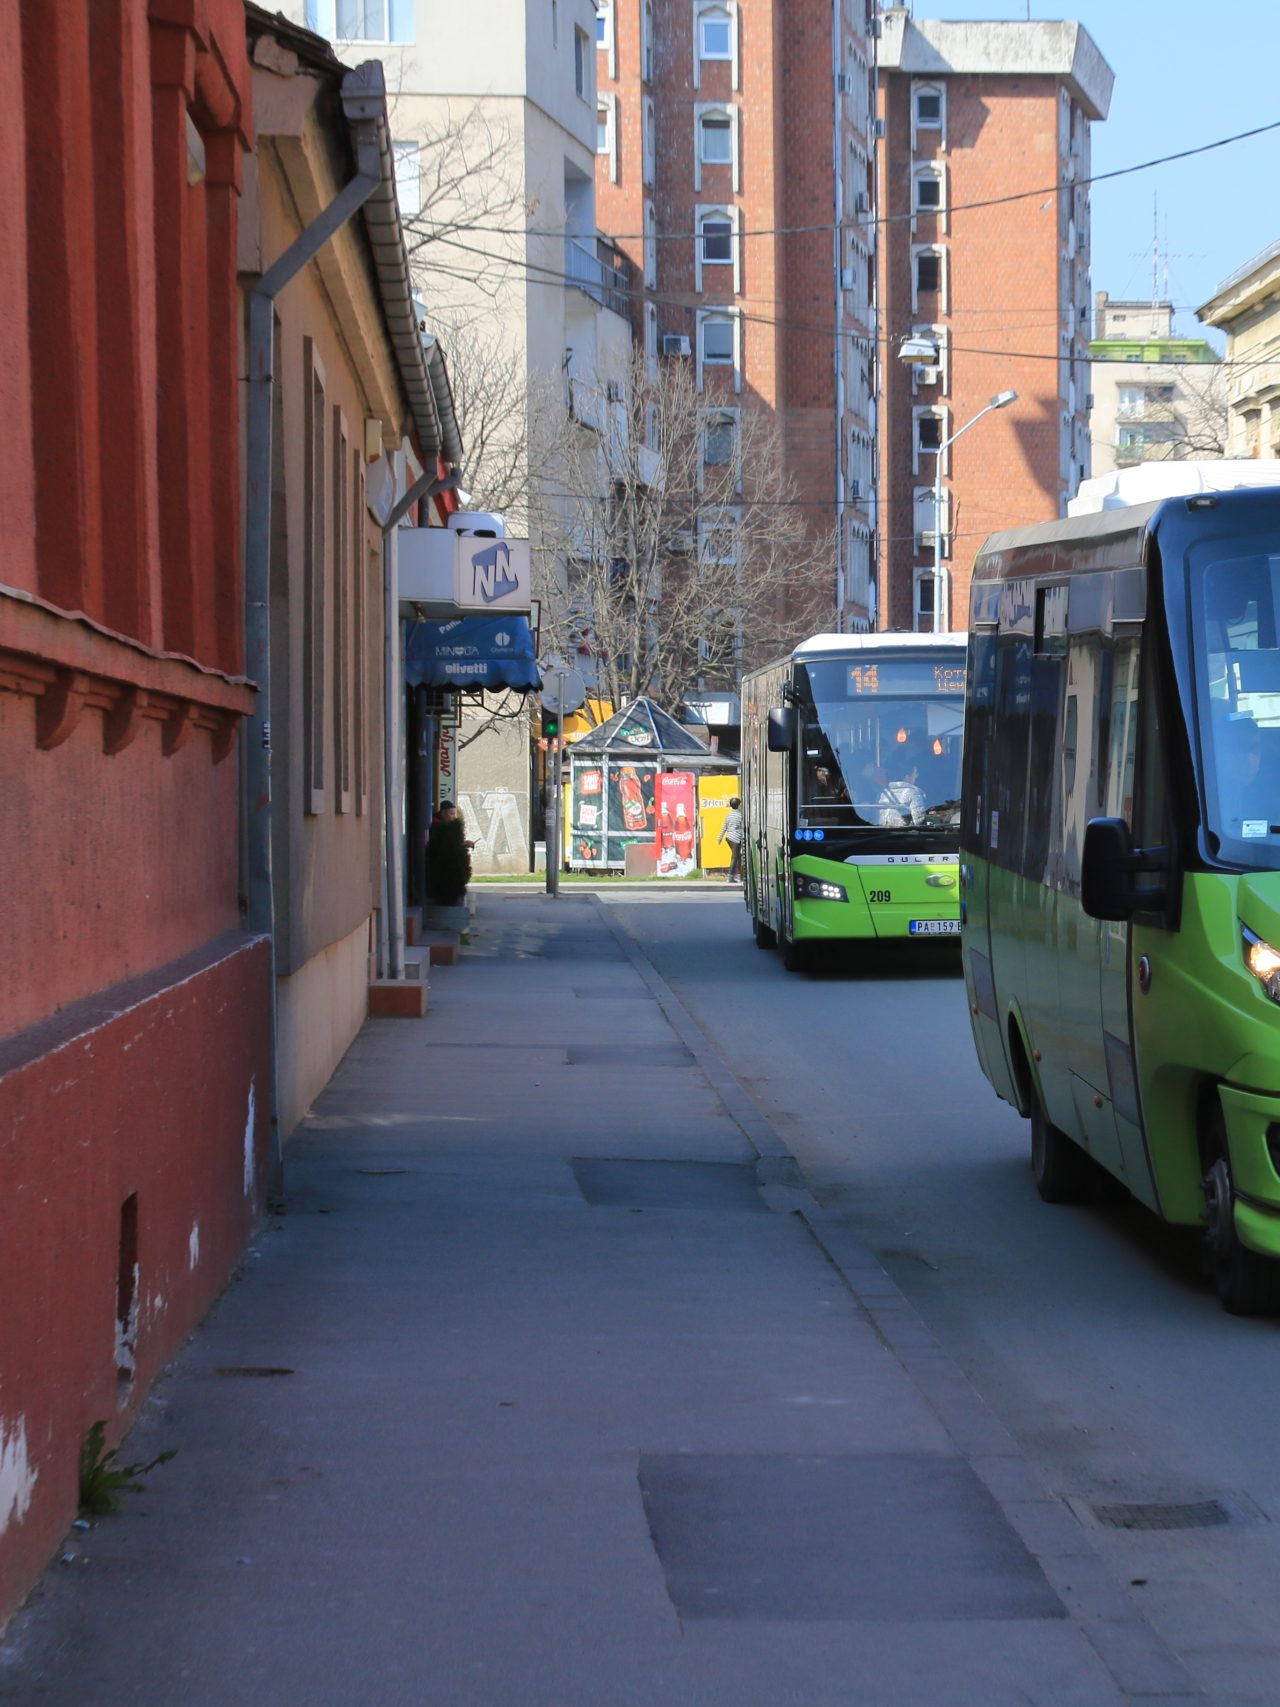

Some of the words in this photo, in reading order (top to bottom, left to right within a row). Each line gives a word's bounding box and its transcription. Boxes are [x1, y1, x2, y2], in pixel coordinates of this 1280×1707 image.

[435, 647, 480, 656] MINOLTA
[445, 663, 488, 674] olivetti
[870, 890, 891, 903] 209
[917, 922, 931, 931] PA
